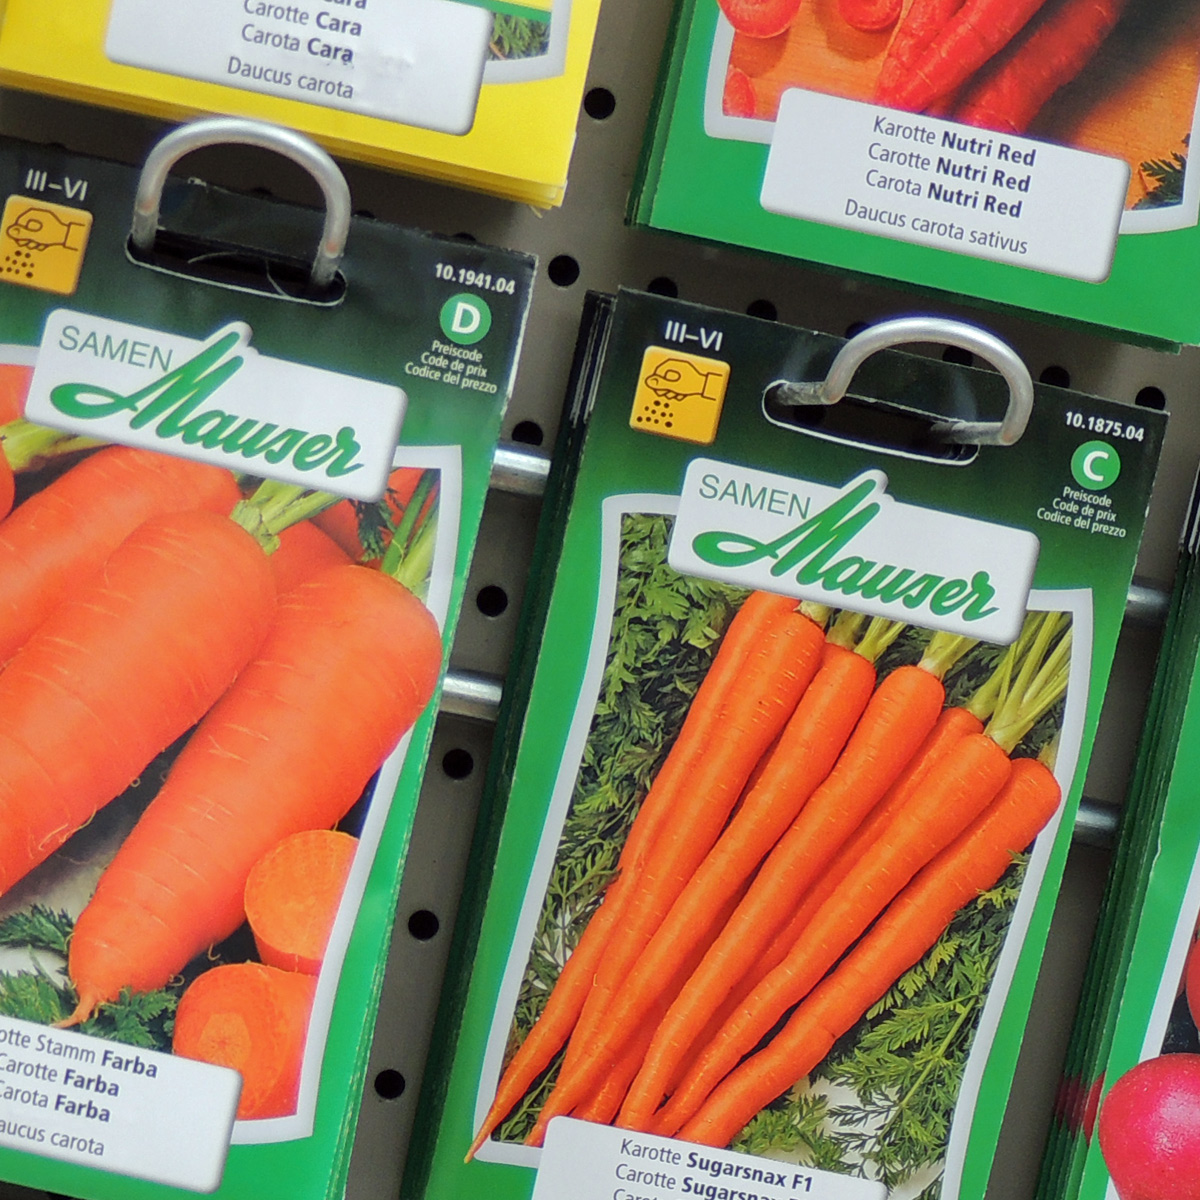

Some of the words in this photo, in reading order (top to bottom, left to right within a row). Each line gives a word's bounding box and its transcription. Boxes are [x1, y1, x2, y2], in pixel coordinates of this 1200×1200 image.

[242, 0, 309, 26] Carotte
[315, 10, 362, 37] Cara
[240, 22, 300, 51] Carota
[306, 36, 354, 66] Cara
[226, 55, 292, 86] Daucus
[296, 75, 354, 99] carota
[872, 114, 936, 145] Karotte
[940, 130, 993, 157] Nutri
[996, 142, 1037, 167] Red
[865, 168, 922, 196] Carota
[926, 181, 979, 209] Nutri
[982, 194, 1023, 218] Red
[844, 198, 906, 227] Daucus
[910, 217, 964, 240] carota
[968, 229, 1028, 254] sativus
[435, 263, 516, 294] 10.1941.04
[451, 302, 480, 334] D
[58, 325, 174, 373] SAMEN
[49, 331, 366, 479] Mauser
[1065, 411, 1144, 442] 10.1875.04
[1083, 450, 1109, 482] C
[699, 473, 812, 520] SAMEN
[1051, 496, 1079, 513] Code
[1080, 503, 1094, 517] de
[1095, 508, 1117, 522] prix
[1061, 485, 1112, 508] Preiscode
[1036, 506, 1072, 525] Codice
[1072, 515, 1091, 529] del
[1090, 518, 1127, 538] prezzo
[692, 478, 1000, 622] Mauser
[0, 1021, 31, 1049] otte
[34, 1033, 96, 1064] Stamm
[100, 1048, 158, 1079] Farba
[62, 1067, 119, 1097] Farba
[620, 1137, 681, 1165] Karotte
[685, 1151, 787, 1188] Sugarsnax
[791, 1173, 812, 1192] F1
